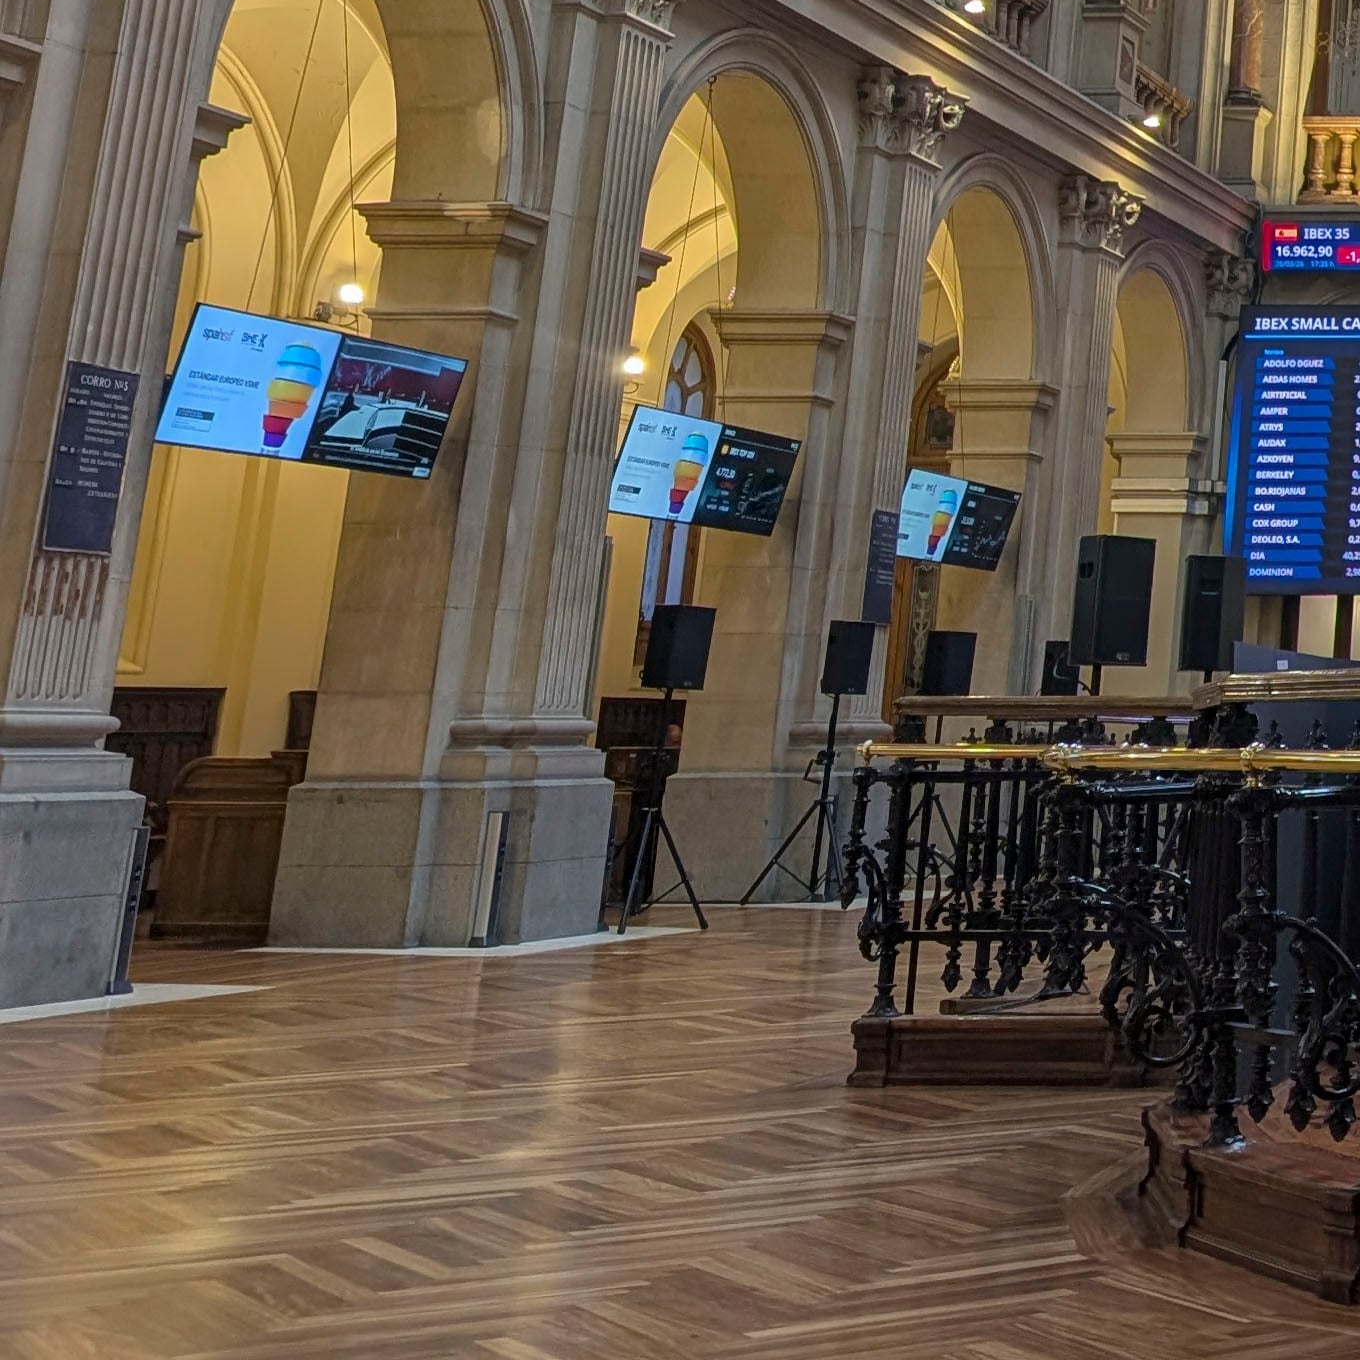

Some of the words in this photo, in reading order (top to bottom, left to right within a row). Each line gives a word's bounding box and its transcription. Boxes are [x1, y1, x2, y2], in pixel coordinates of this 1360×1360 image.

[1304, 228, 1333, 240] IBEX
[1335, 228, 1350, 240] 35
[1276, 246, 1332, 259] 16.962,90
[1255, 318, 1288, 330] IBEX
[1292, 318, 1339, 330] SMALL
[1264, 360, 1296, 368] ADOLFO
[81, 374, 111, 389] CORRO
[1256, 455, 1294, 463] AZKOYEN
[1254, 504, 1275, 512] CASH
[1250, 552, 1265, 560] DIA
[1249, 568, 1293, 576] DOMINION
